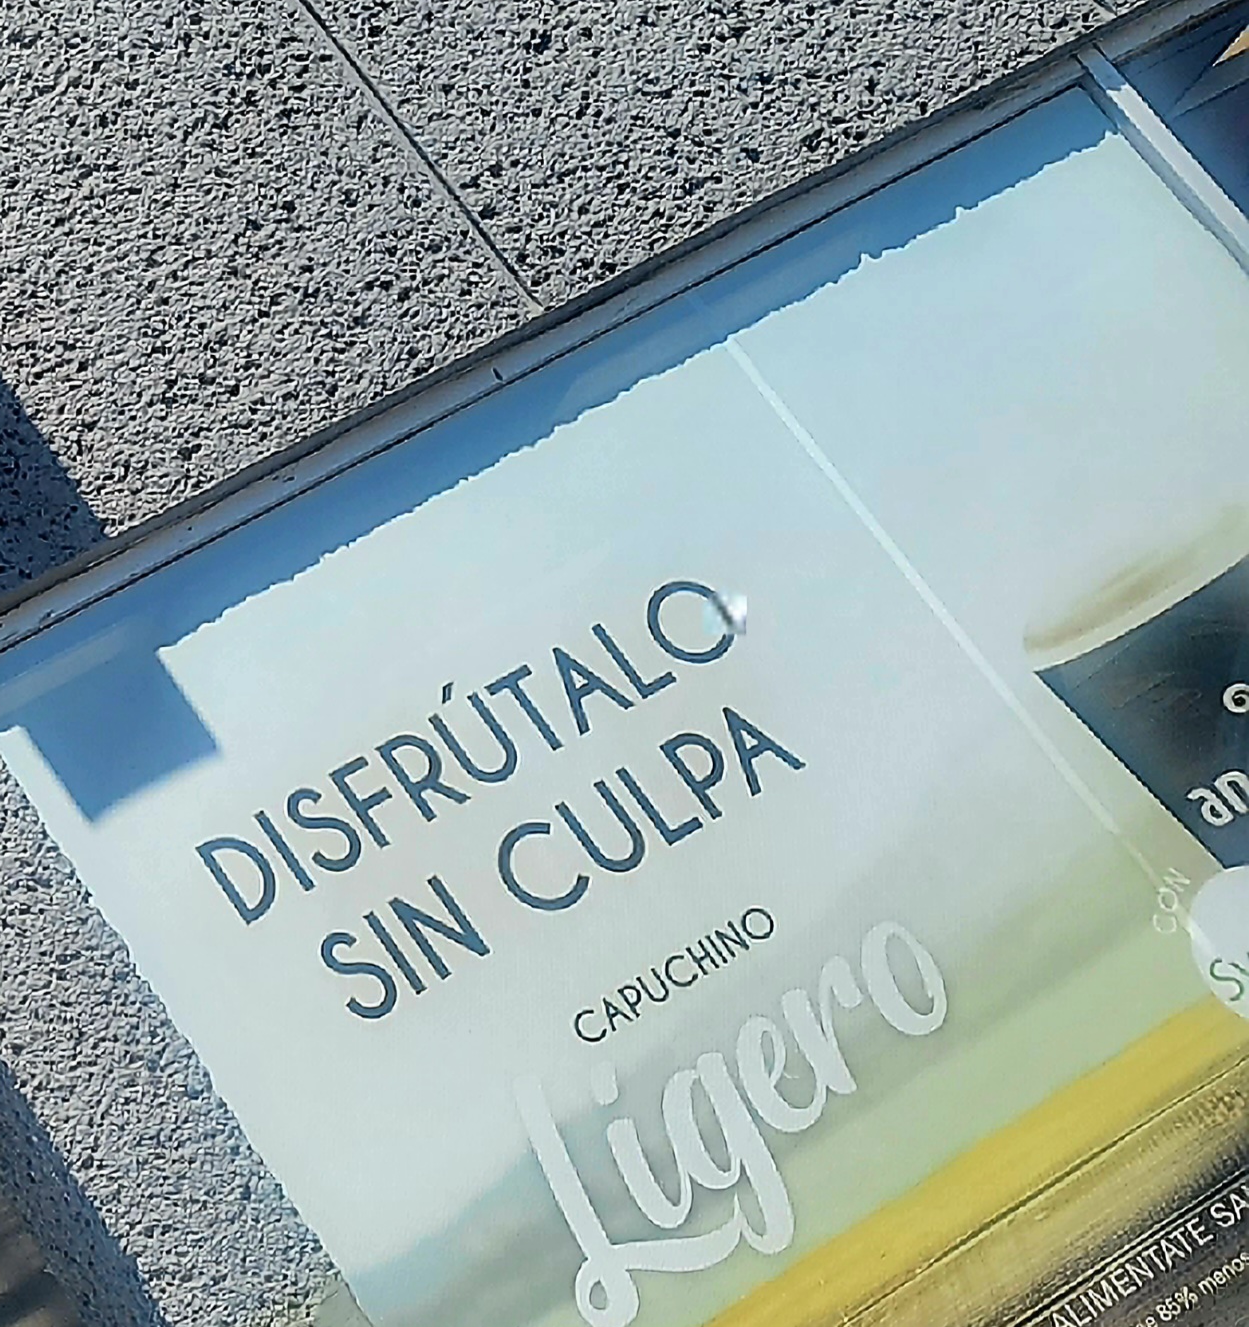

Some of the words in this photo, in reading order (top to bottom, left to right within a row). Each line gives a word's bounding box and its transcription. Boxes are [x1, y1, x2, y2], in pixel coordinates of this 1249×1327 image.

[195, 579, 739, 926] DISFRÚTALO
[320, 875, 491, 1020] SIN
[497, 706, 806, 912] CULPA
[1153, 866, 1191, 935] CON
[573, 907, 776, 1043] CAPUCHINO
[1155, 1285, 1199, 1322] 85%
